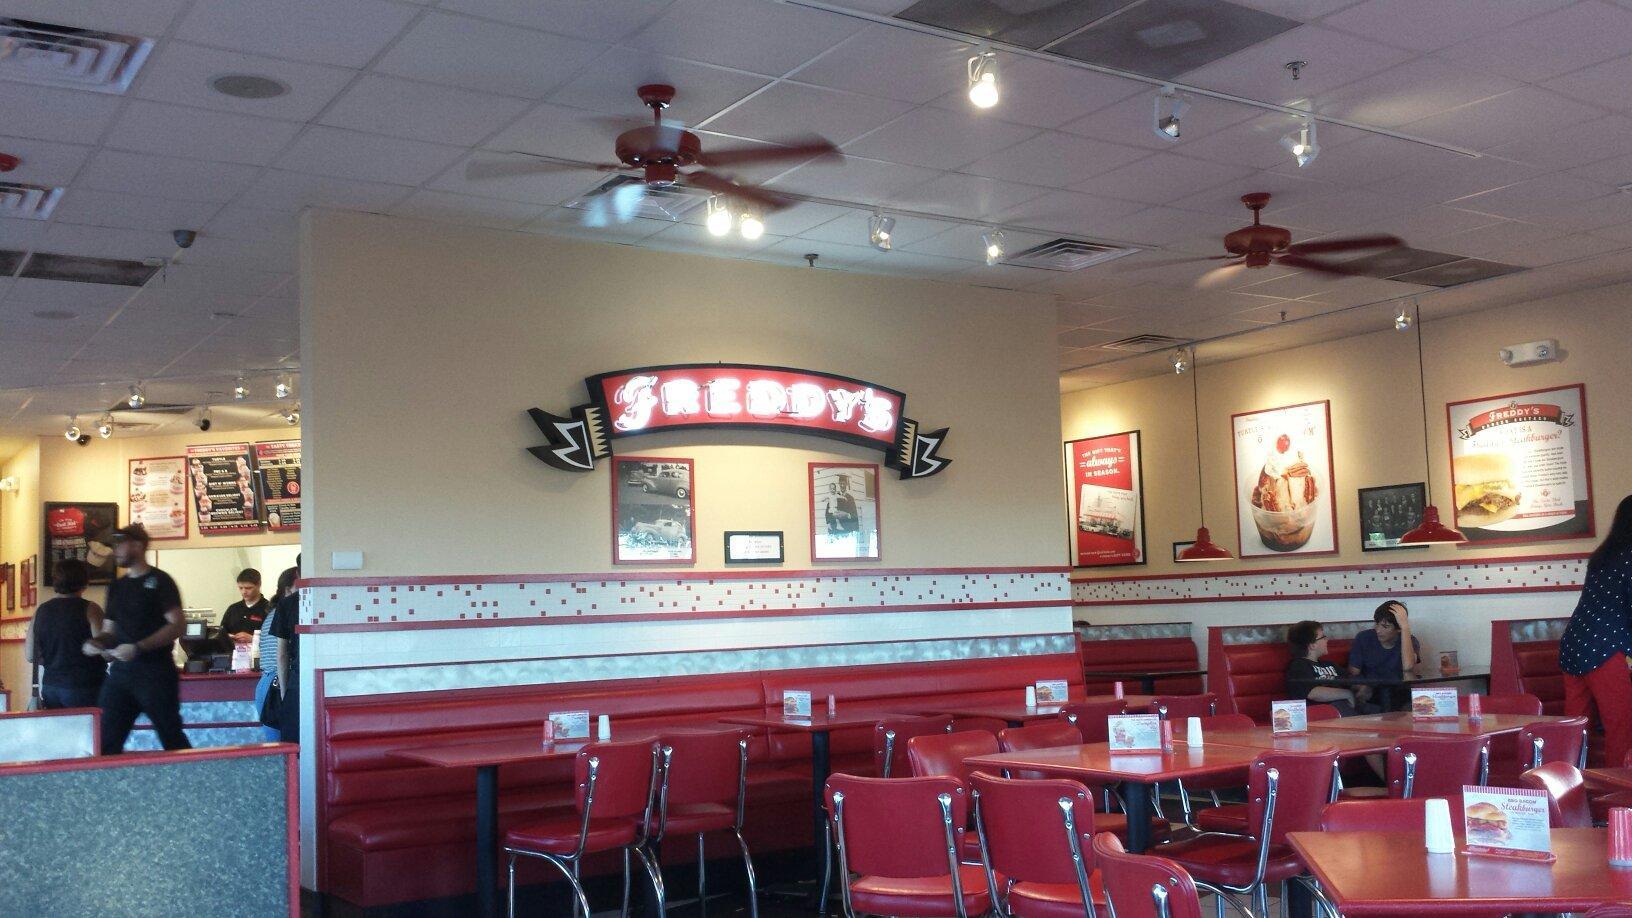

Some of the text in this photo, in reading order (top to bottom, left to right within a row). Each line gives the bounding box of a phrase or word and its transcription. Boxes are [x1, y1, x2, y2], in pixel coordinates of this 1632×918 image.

[614, 376, 893, 432] FREDDY'S
[1489, 407, 1540, 422] FREDDY'S
[1086, 456, 1118, 469] always
